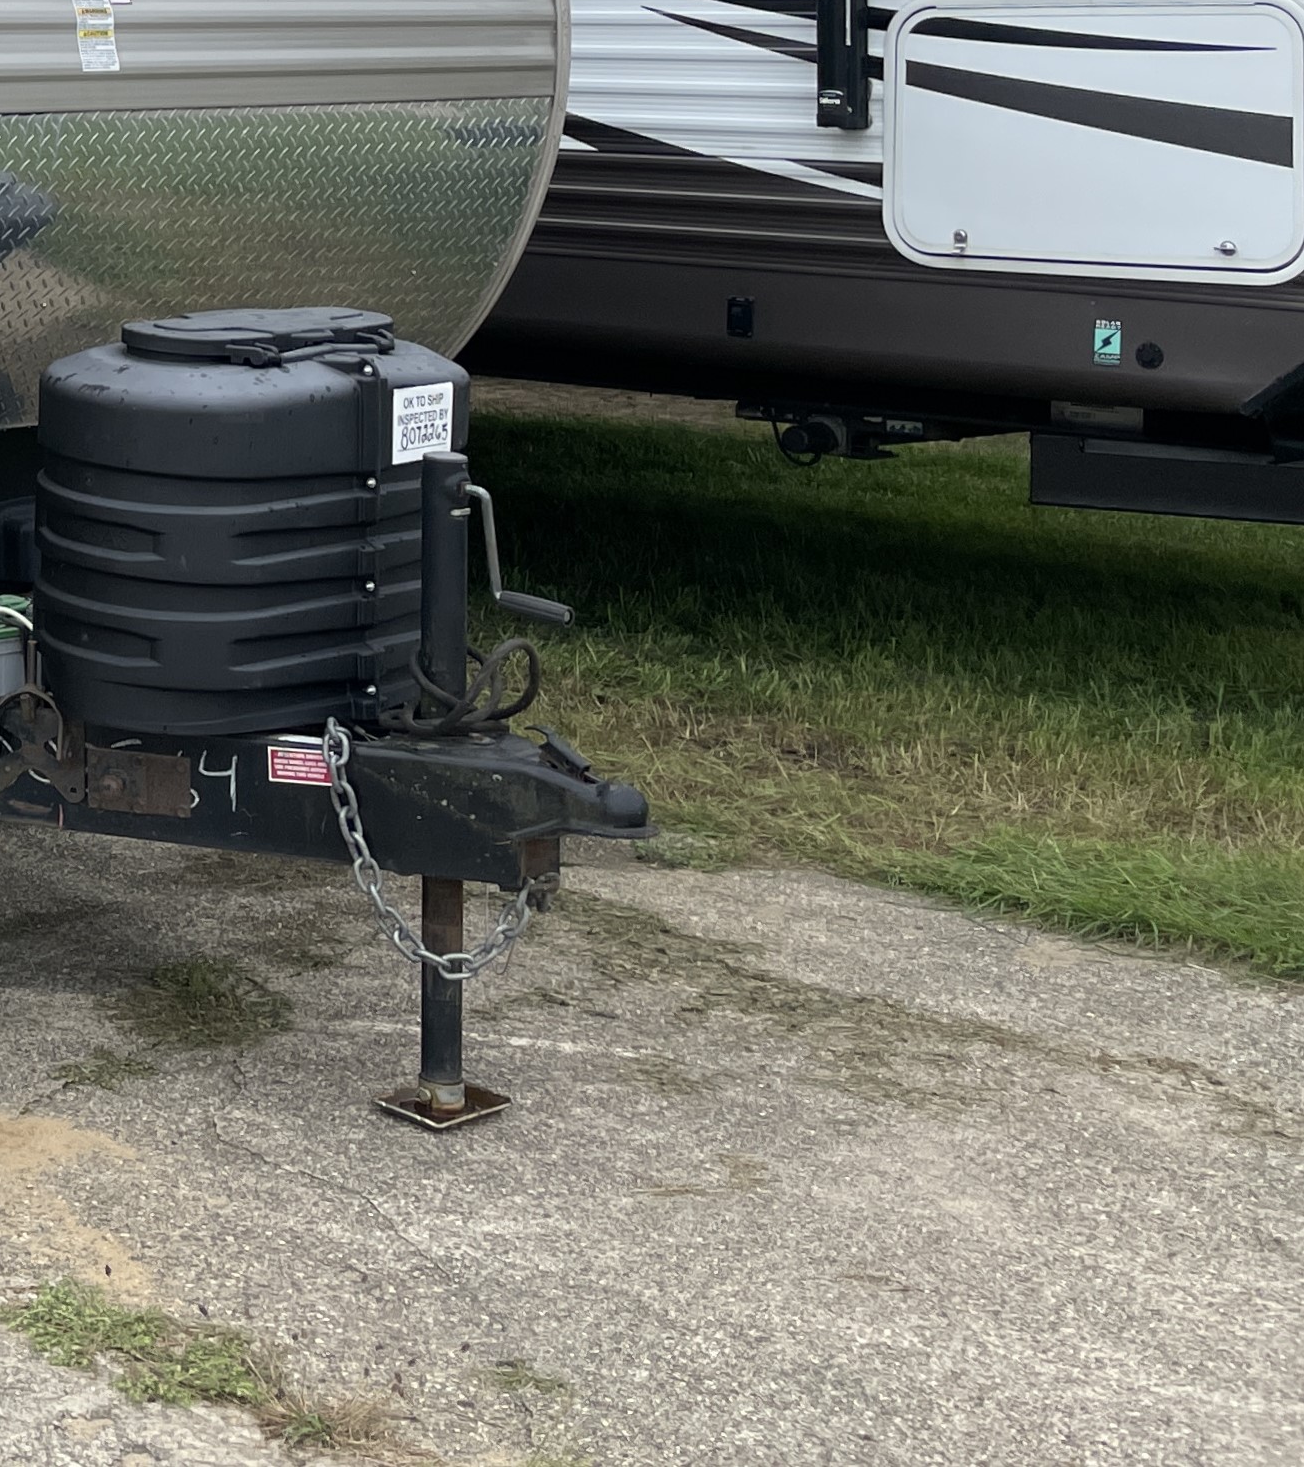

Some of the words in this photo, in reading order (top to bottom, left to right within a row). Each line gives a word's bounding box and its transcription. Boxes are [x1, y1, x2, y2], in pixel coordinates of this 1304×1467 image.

[403, 396, 414, 409] OK
[416, 395, 426, 407] TO
[427, 392, 444, 406] SHIP
[397, 411, 438, 426] INSPECTED
[439, 409, 449, 421] BY
